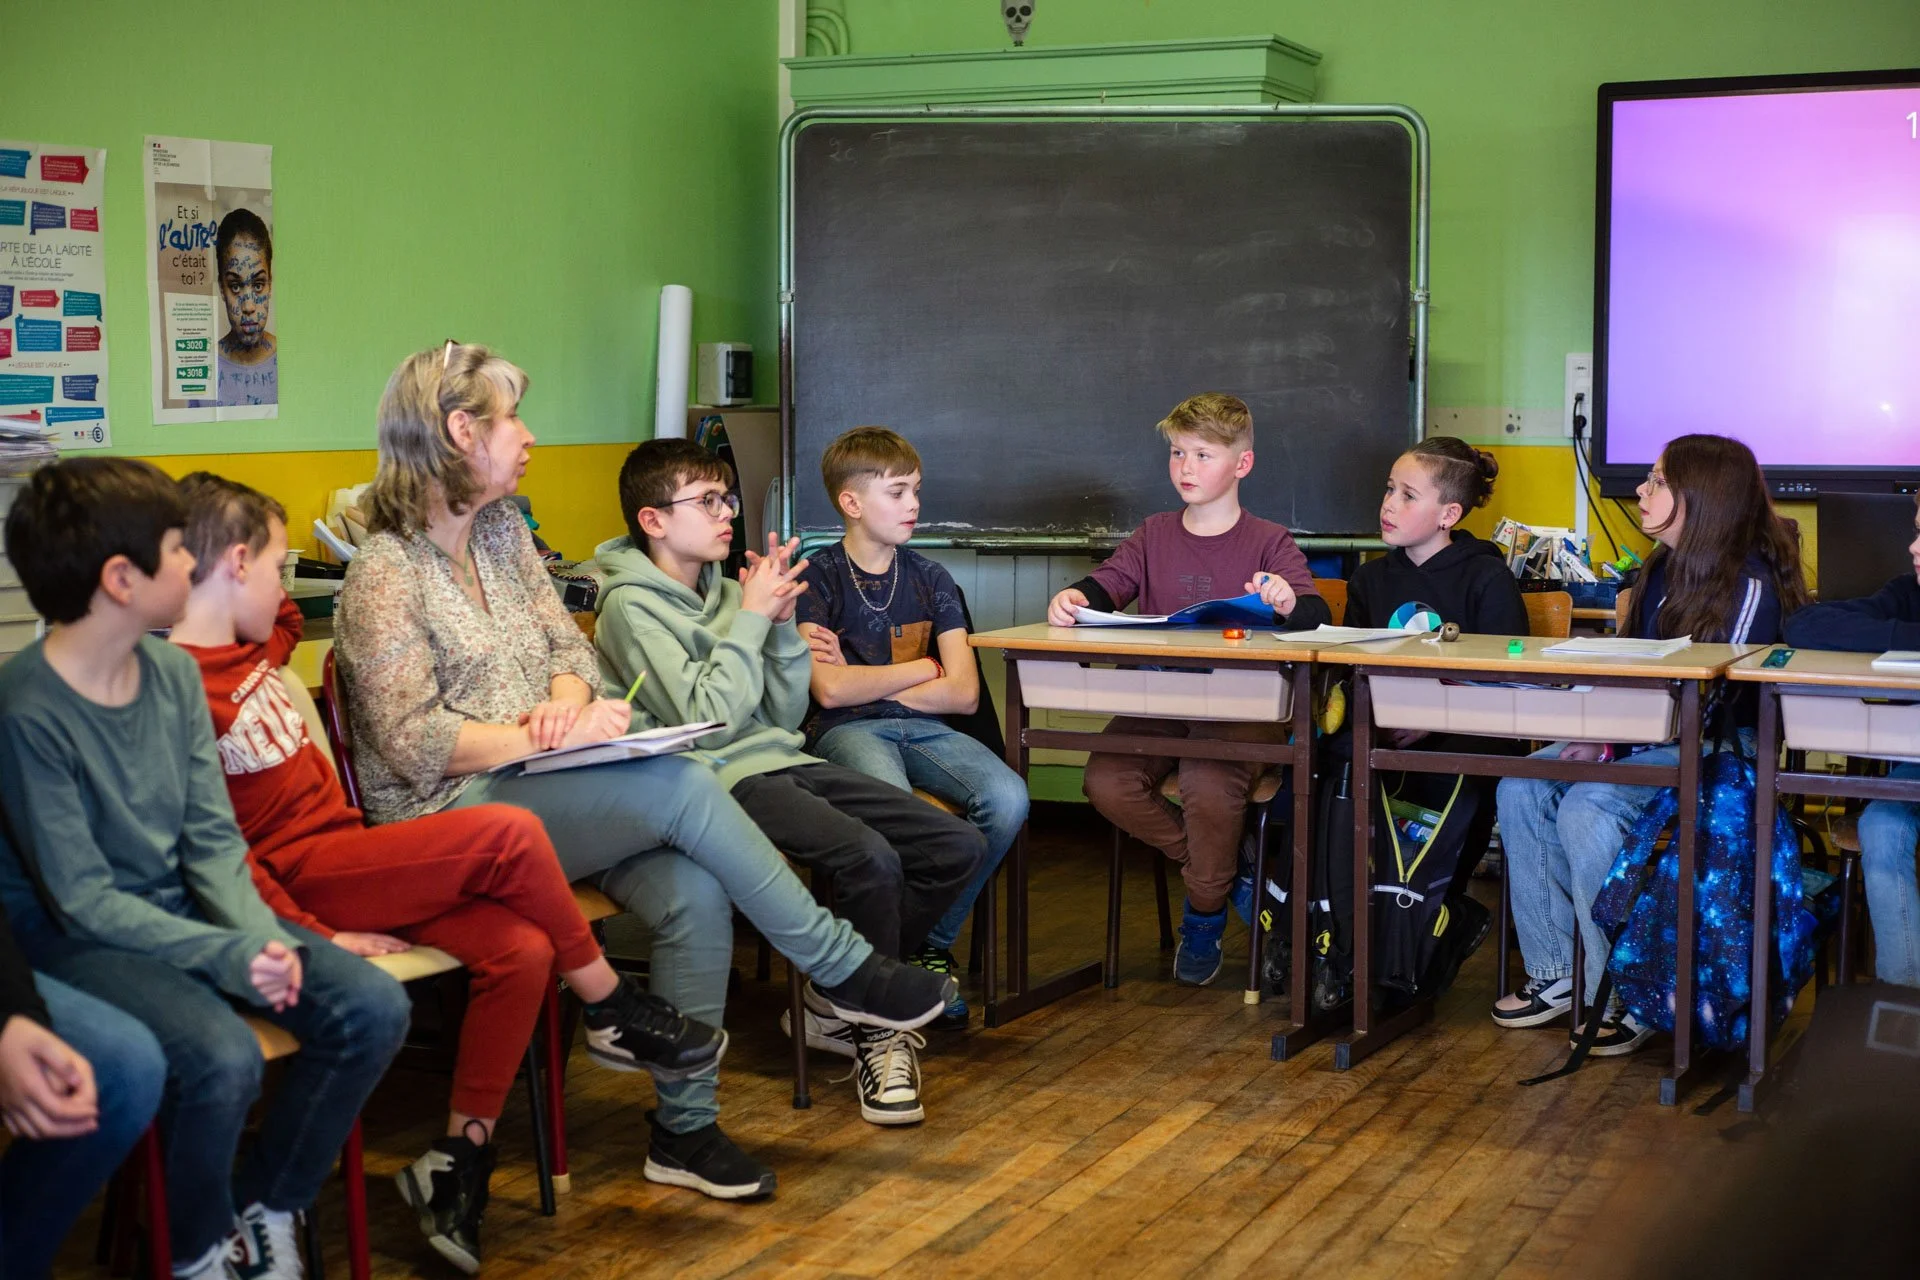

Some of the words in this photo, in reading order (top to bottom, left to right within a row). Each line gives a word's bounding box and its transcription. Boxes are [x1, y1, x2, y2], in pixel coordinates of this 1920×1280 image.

[177, 205, 189, 219] Et
[191, 205, 199, 220] si
[0, 241, 20, 254] RTE
[23, 242, 36, 254] DE
[39, 244, 53, 255] LA
[21, 256, 62, 269] L'ÉCOLE
[172, 253, 207, 268] c'était
[181, 271, 196, 286] toi
[186, 340, 203, 350] 3020
[186, 368, 203, 378] 3018
[866, 1029, 895, 1042] adidas
